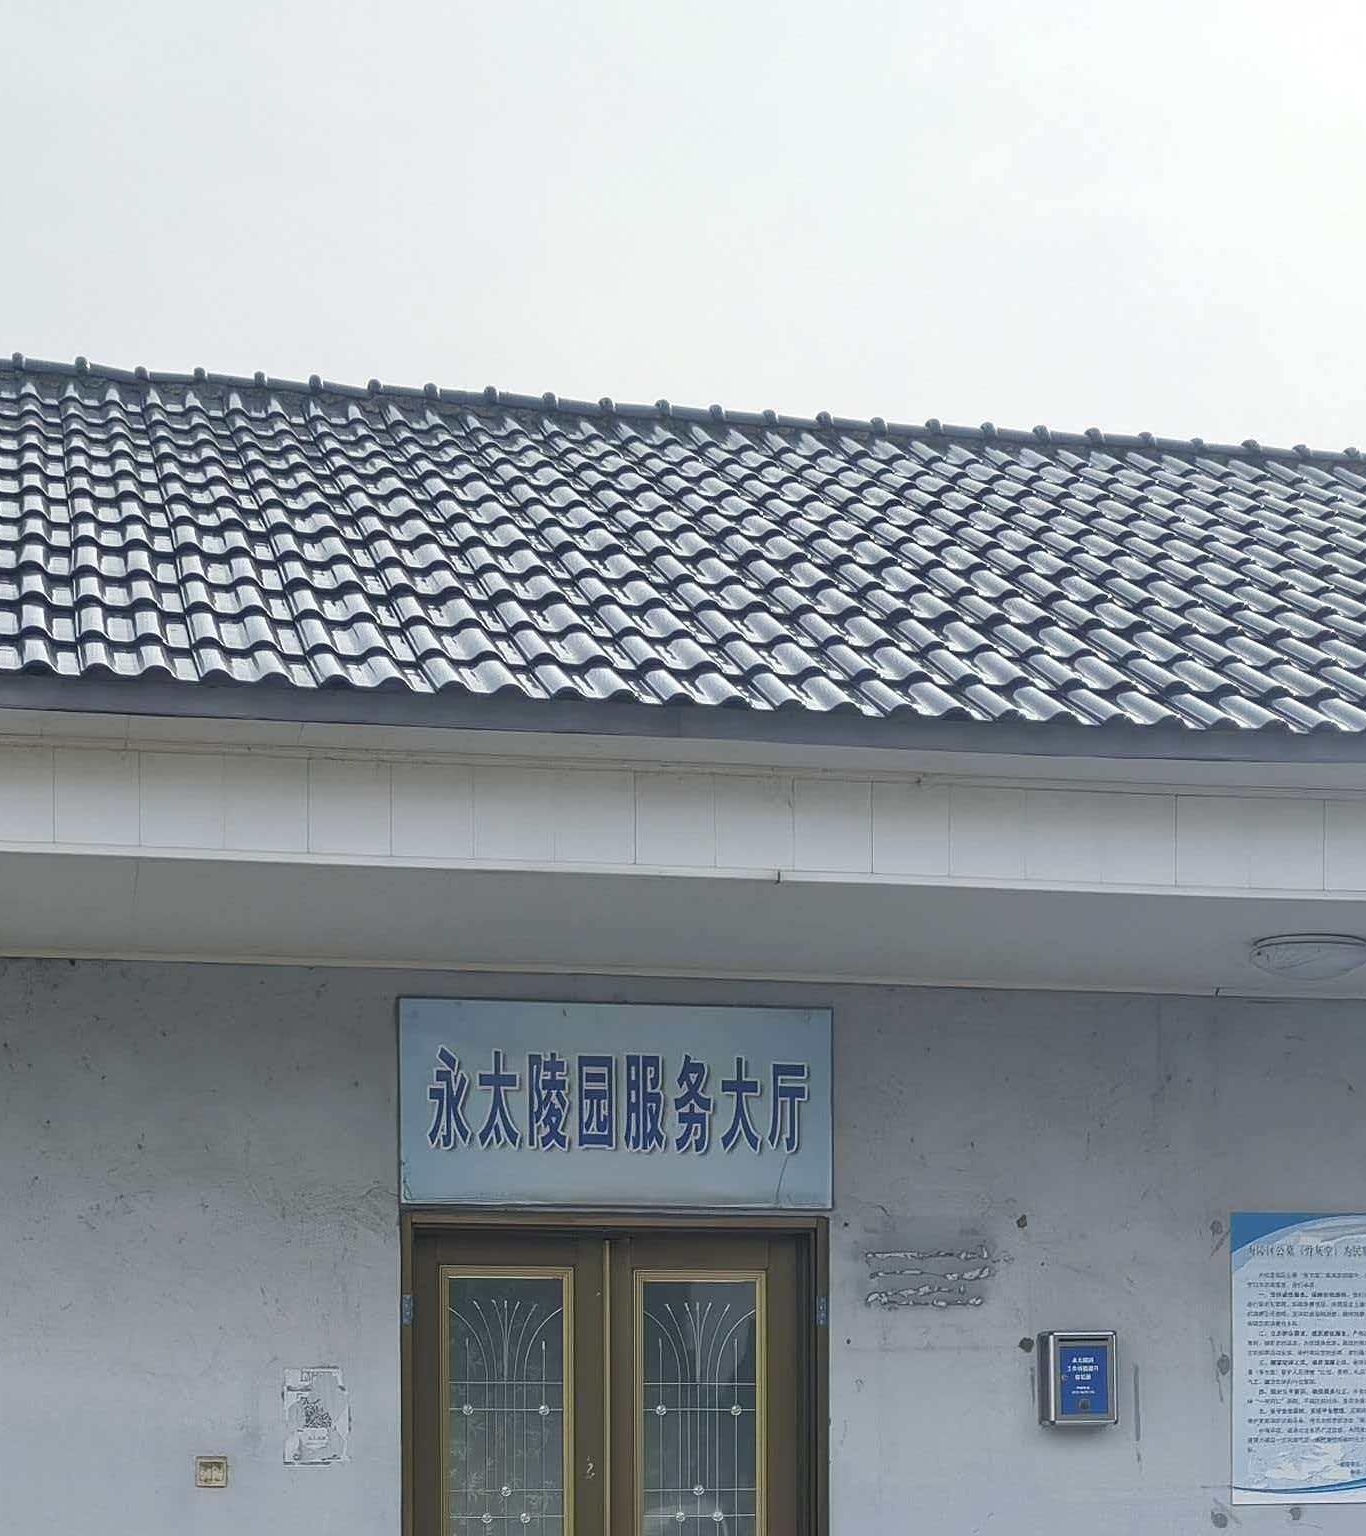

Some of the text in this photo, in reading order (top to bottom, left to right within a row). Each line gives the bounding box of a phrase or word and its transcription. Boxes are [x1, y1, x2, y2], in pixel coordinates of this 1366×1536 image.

[426, 1044, 811, 1155] 永太陵园服务大厅
